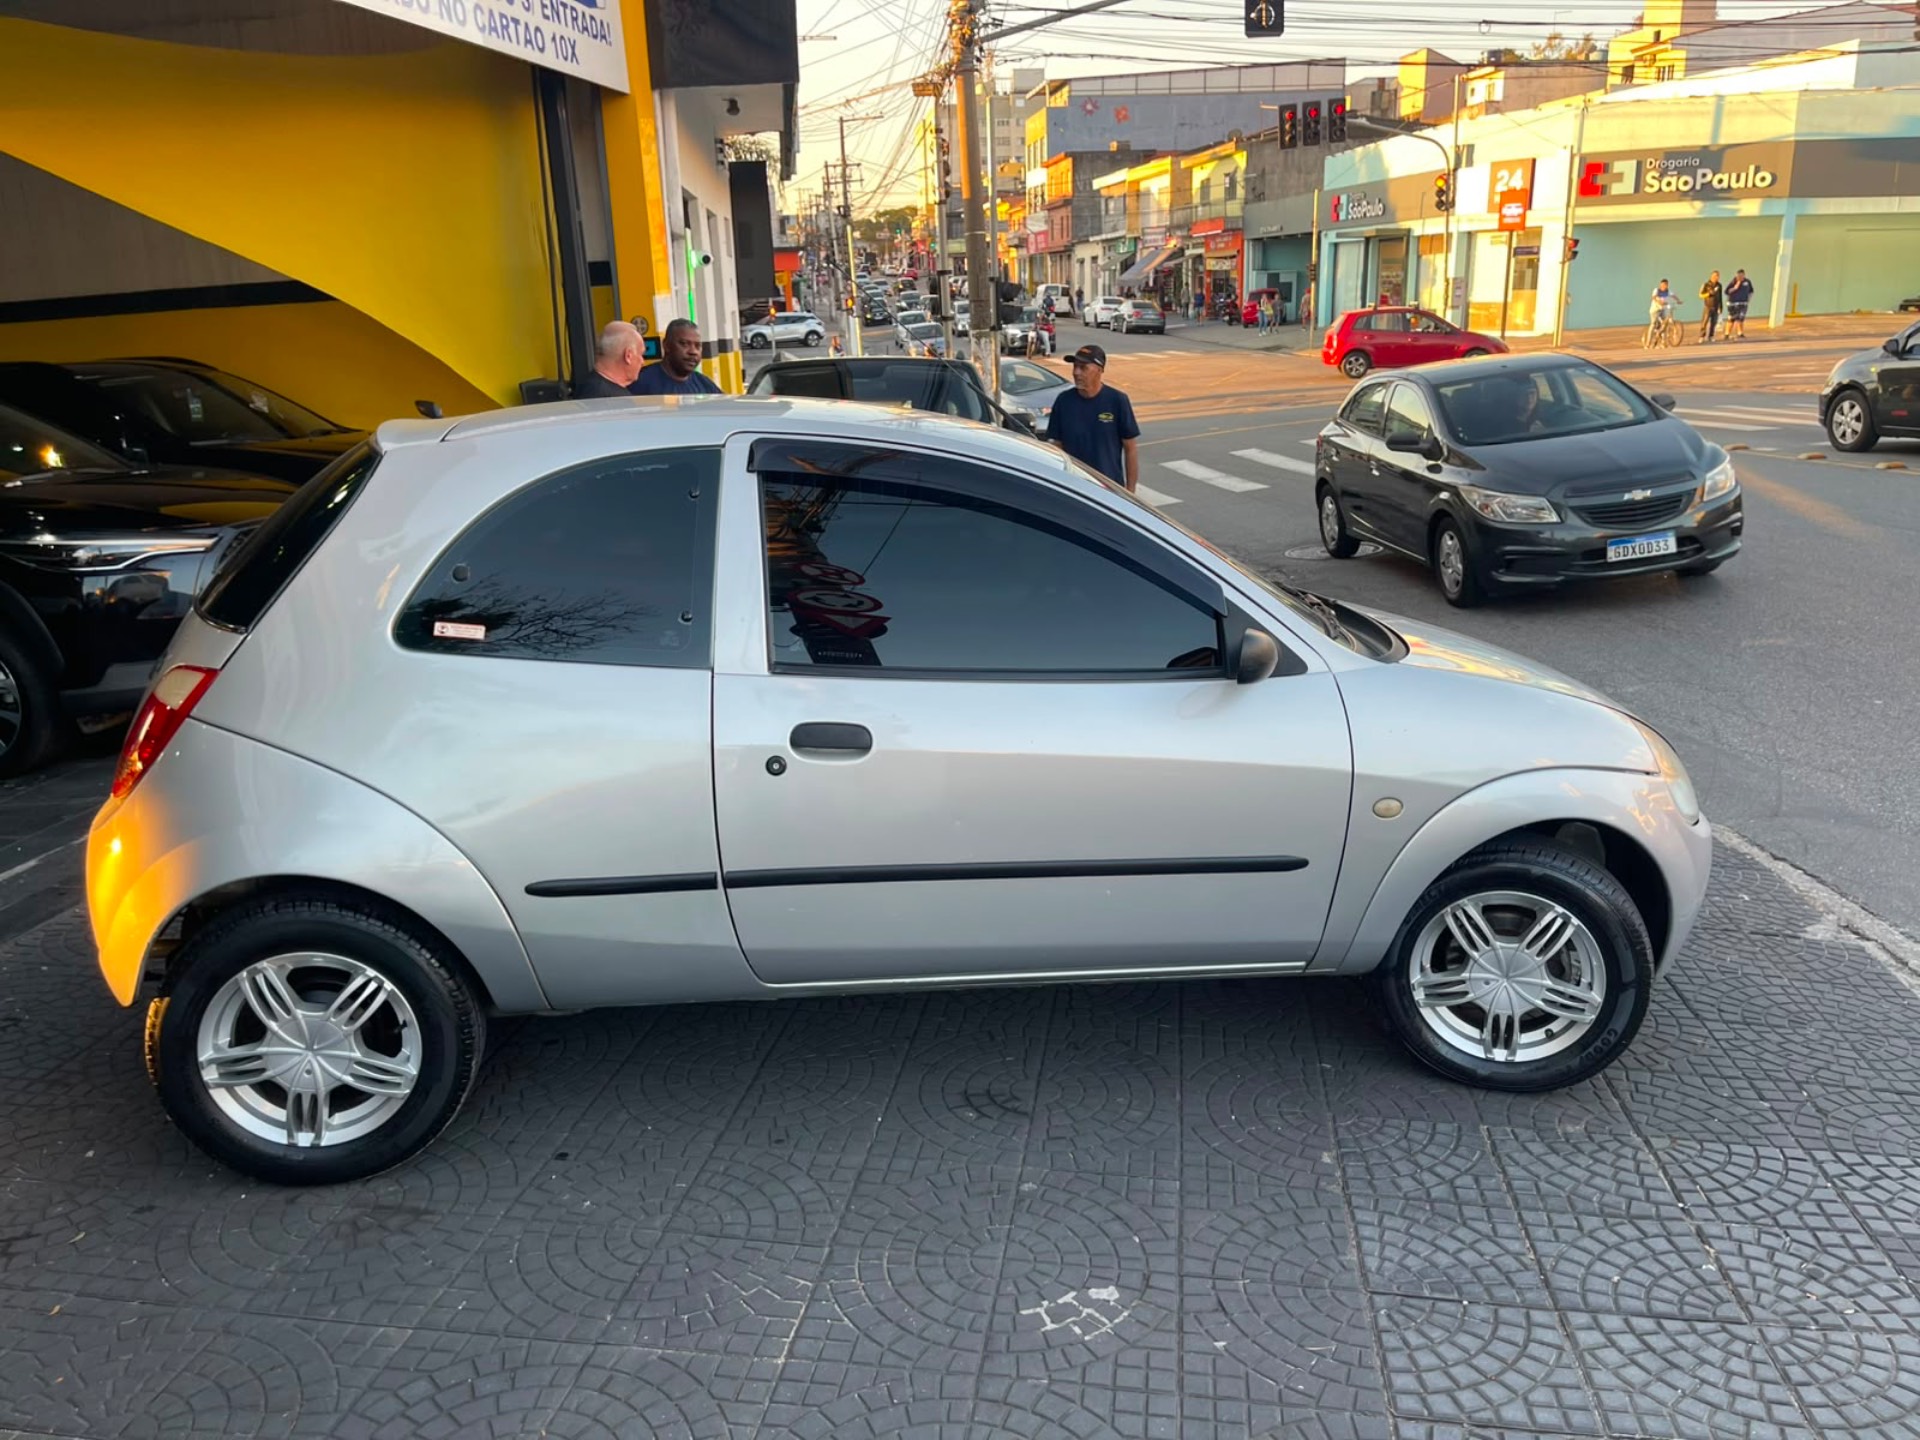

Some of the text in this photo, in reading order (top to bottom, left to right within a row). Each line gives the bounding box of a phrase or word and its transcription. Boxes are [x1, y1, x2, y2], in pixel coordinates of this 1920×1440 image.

[439, 0, 467, 28] NO
[473, 3, 546, 54] CARTAO
[551, 32, 580, 65] 10X
[540, 0, 613, 47] ENTRADA!
[1494, 167, 1525, 192] 24
[1646, 156, 1700, 169] Drogaria
